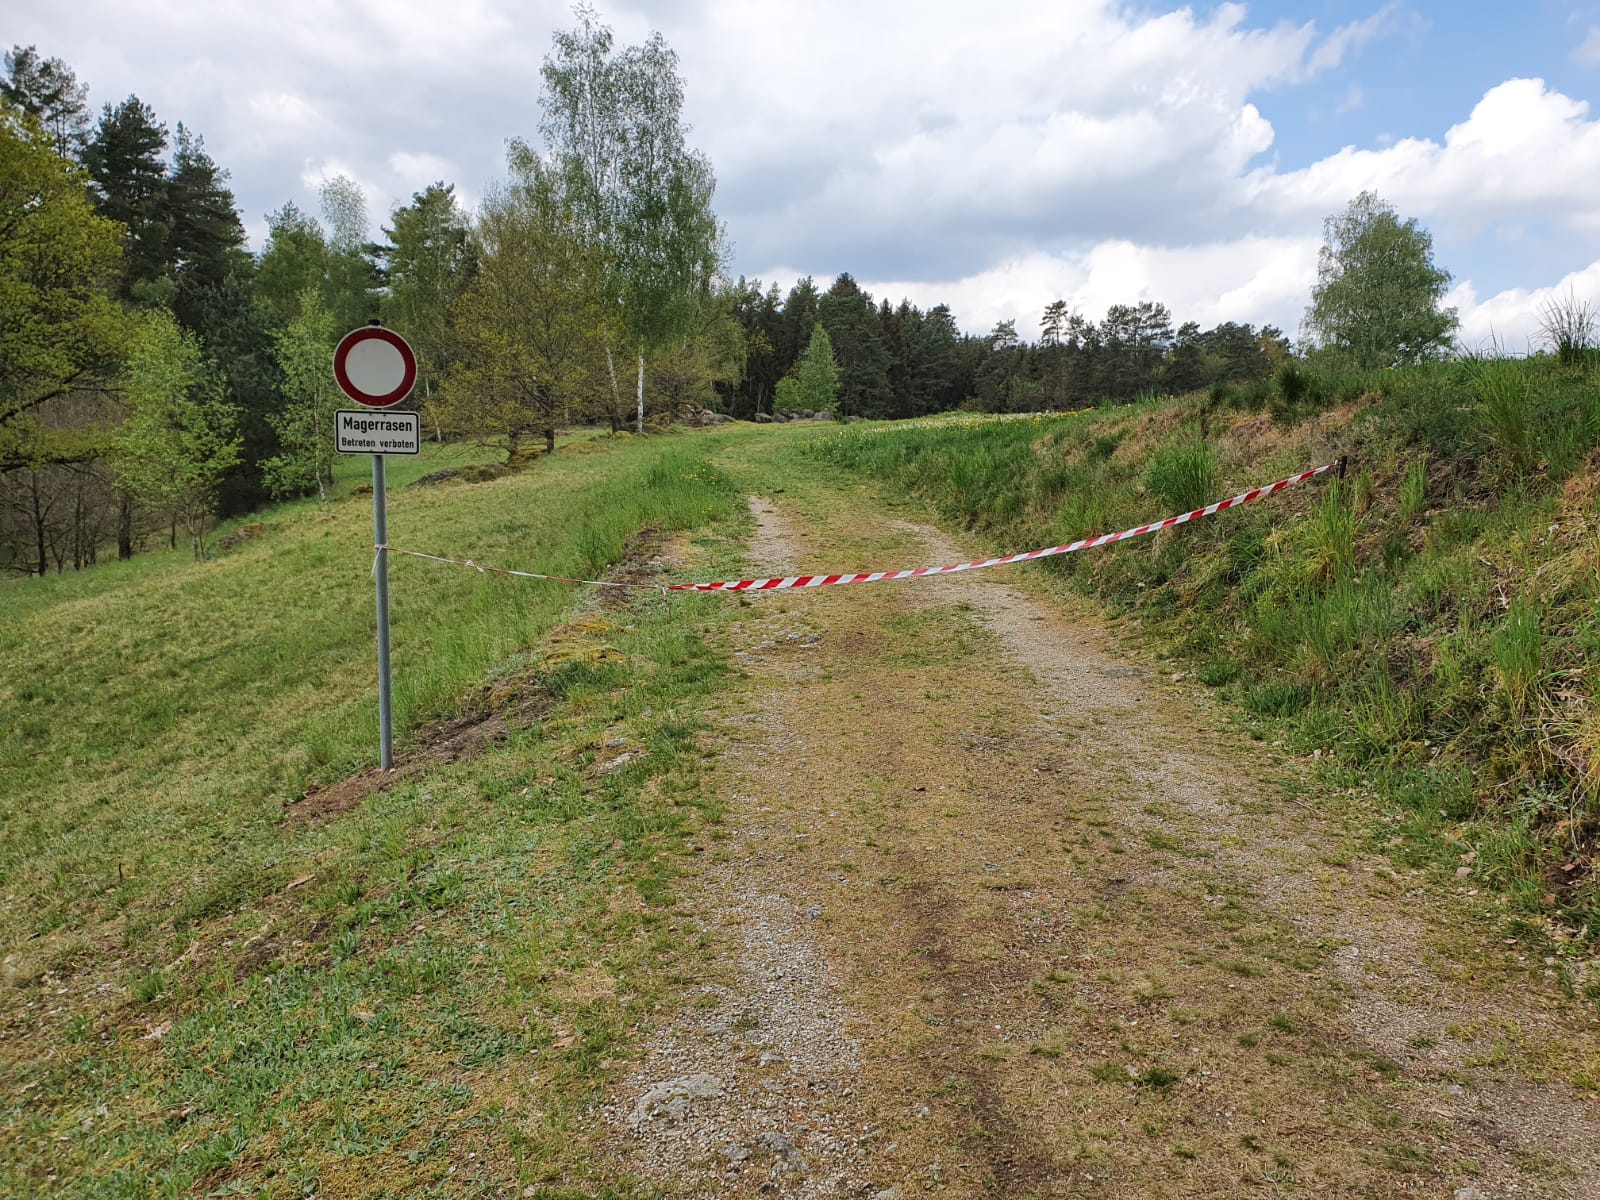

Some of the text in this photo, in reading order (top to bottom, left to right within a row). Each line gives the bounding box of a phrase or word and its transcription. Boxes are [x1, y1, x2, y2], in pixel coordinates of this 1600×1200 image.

[343, 416, 412, 433] Magerrasen
[341, 437, 415, 448] Betreten verboten
